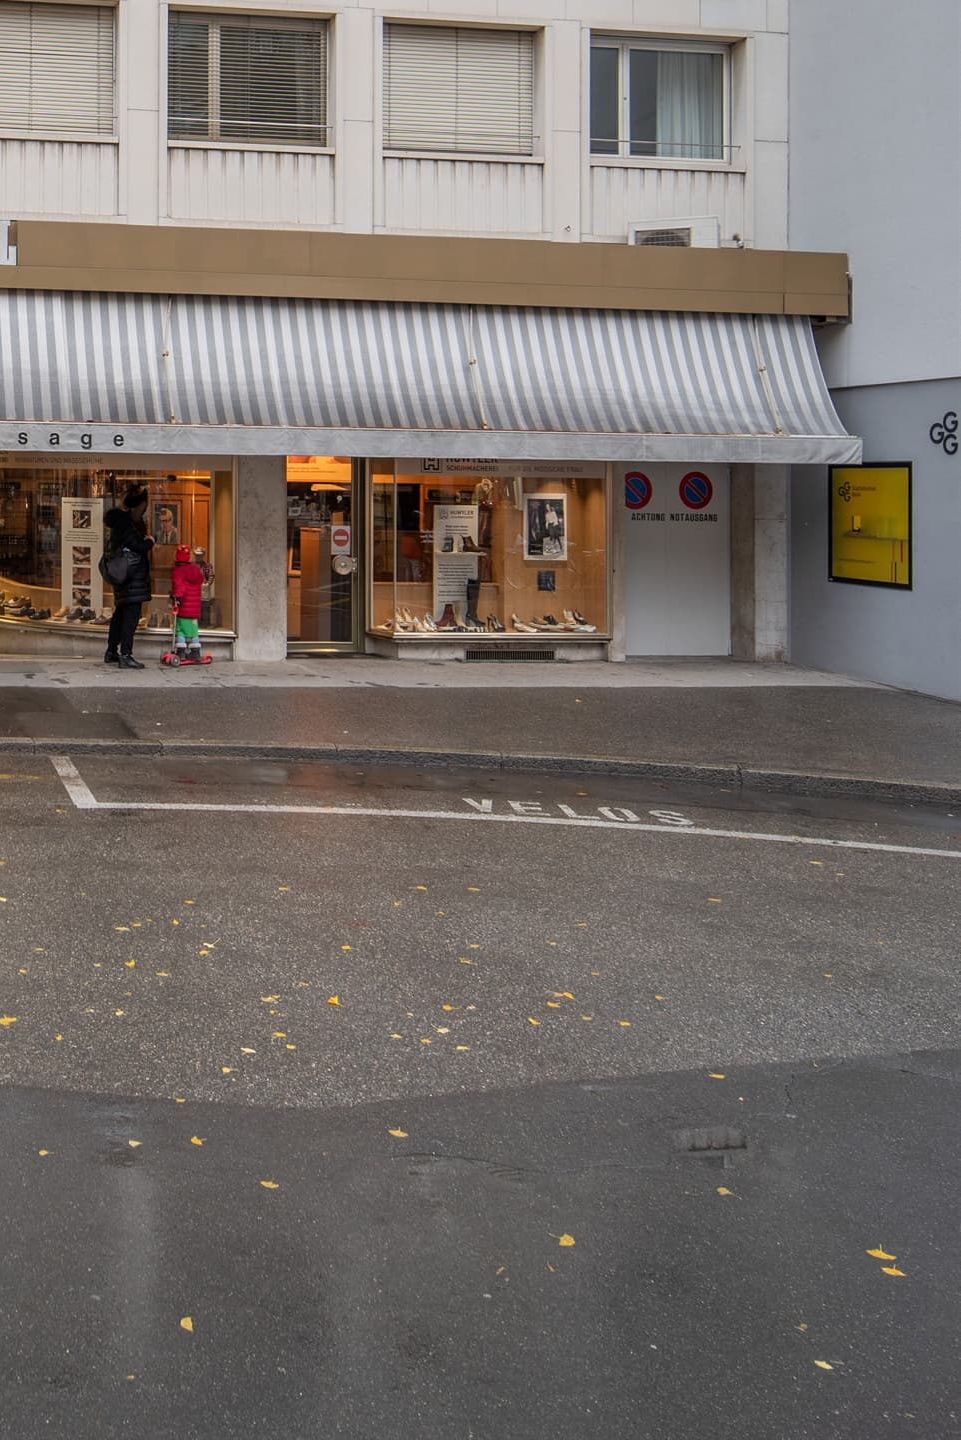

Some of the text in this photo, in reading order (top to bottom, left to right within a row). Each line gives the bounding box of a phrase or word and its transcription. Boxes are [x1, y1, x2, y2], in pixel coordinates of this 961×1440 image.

[631, 512, 718, 523] ACHTUNG NOTAUSGANG
[462, 797, 695, 826] VELOS
